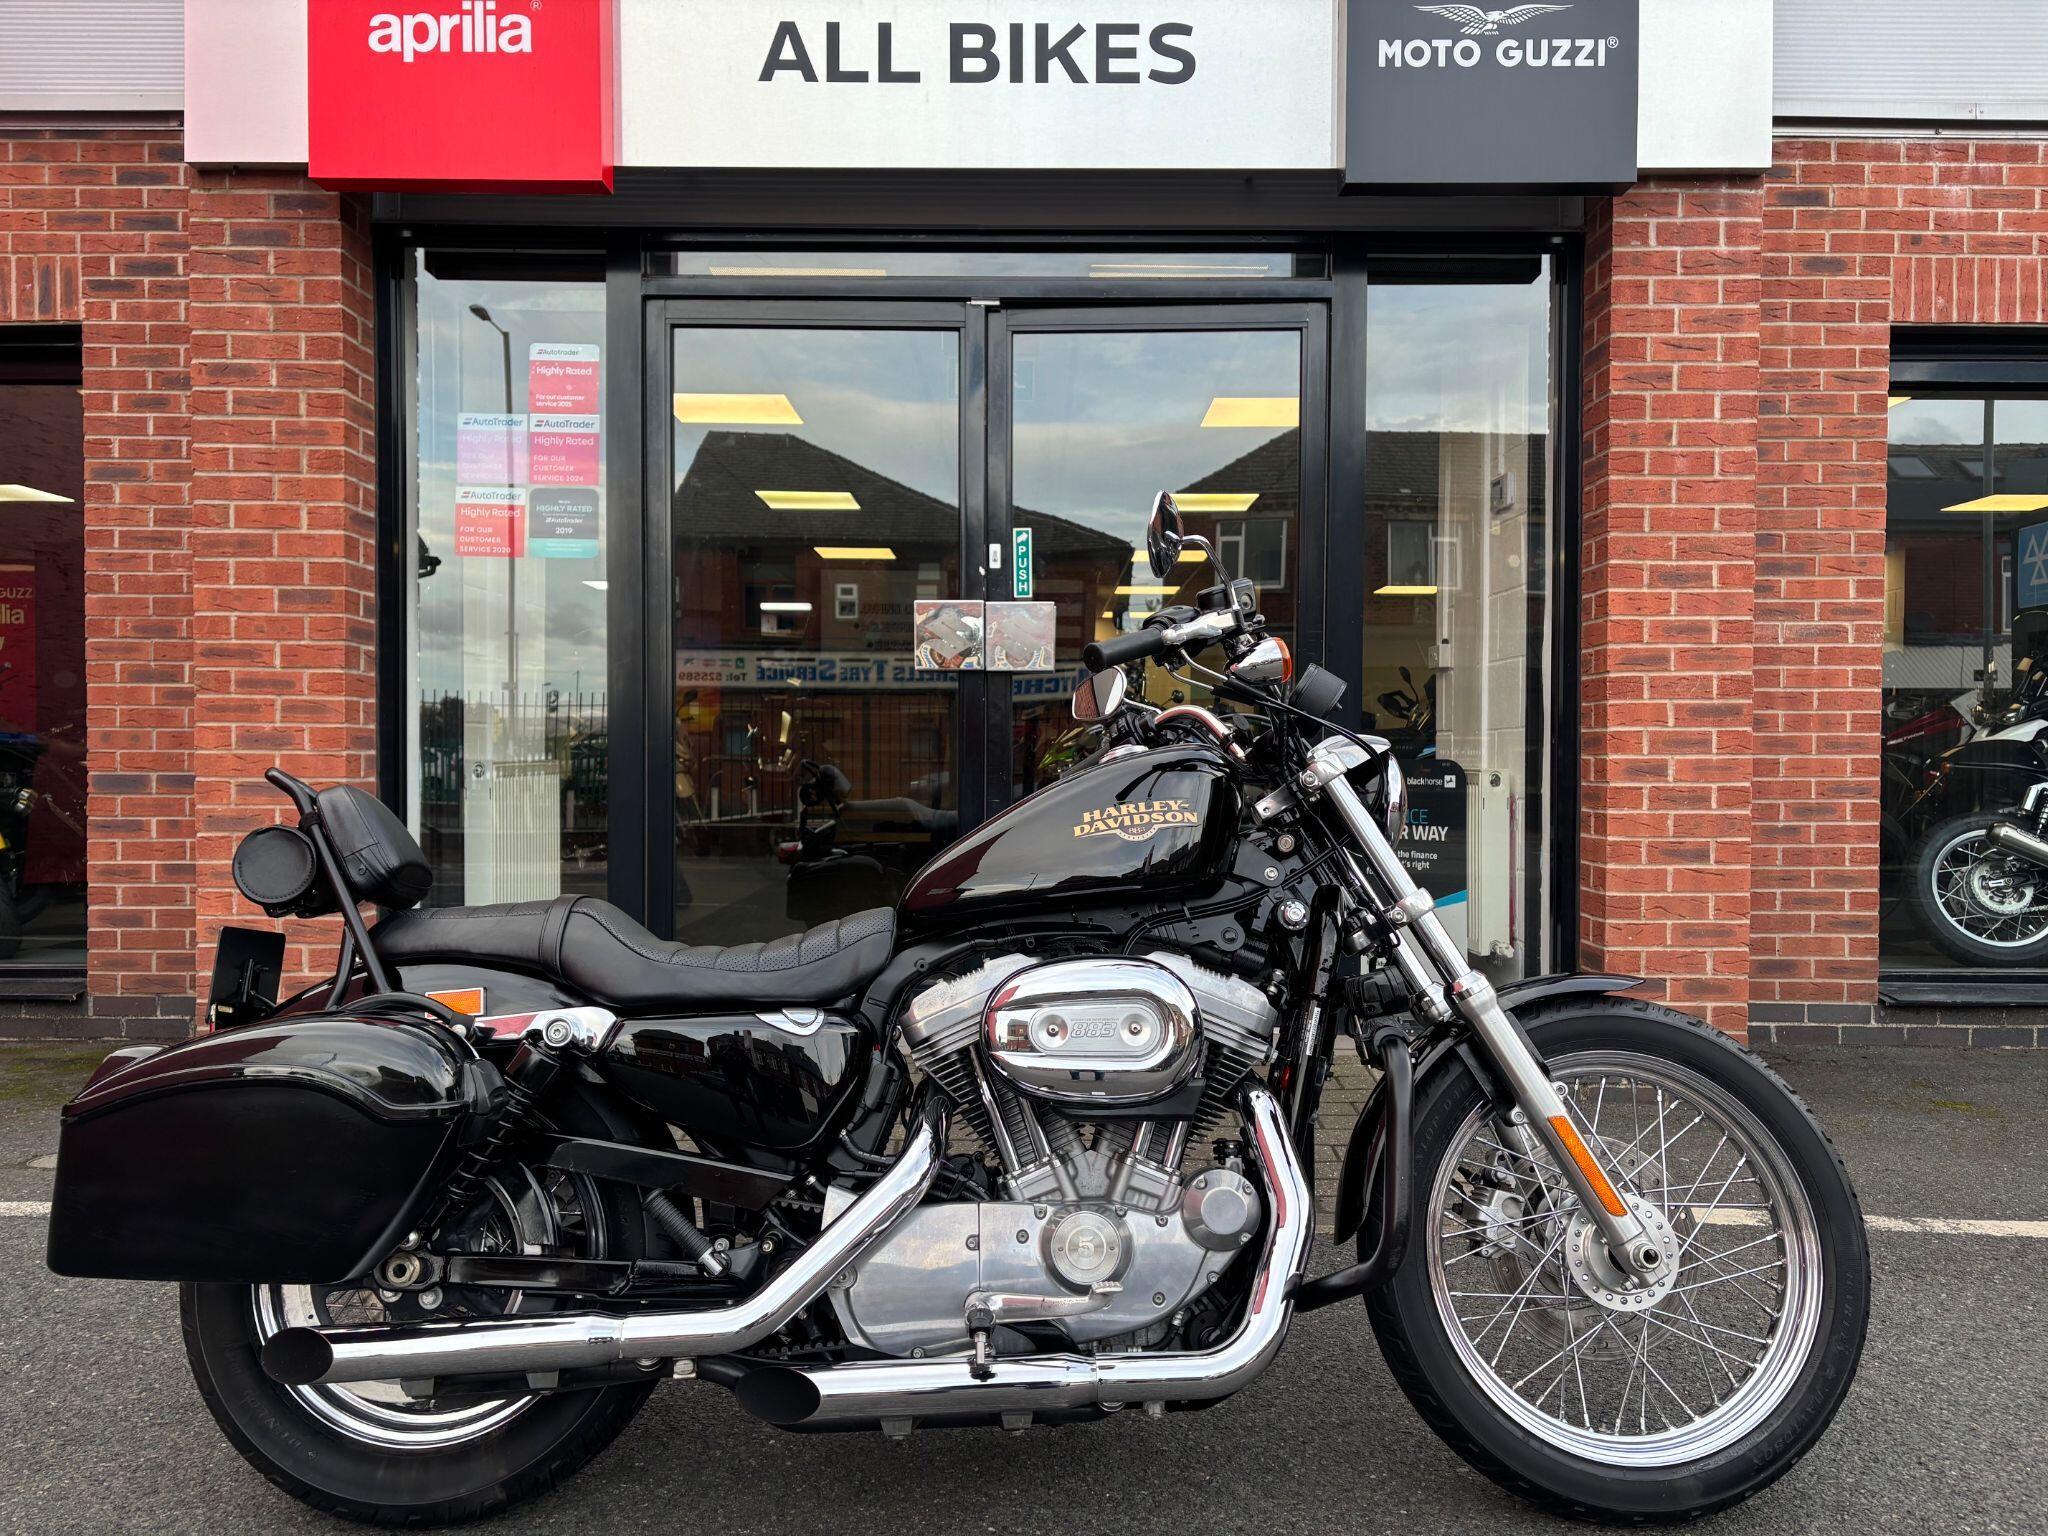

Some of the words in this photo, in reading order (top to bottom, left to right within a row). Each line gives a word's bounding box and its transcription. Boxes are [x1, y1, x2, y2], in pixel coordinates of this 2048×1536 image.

[367, 0, 533, 63] aprilia
[757, 20, 921, 84] ALL
[949, 21, 1197, 85] BIKES
[1377, 38, 1482, 68] MOTO
[1495, 38, 1606, 68] GUZZI
[536, 366, 564, 377] Highly
[565, 366, 592, 376] Rated
[472, 417, 524, 427] AutoTrader
[543, 419, 595, 429] AutoTrader
[534, 435, 564, 447] Highly
[565, 436, 594, 446] Rated
[470, 491, 521, 500] AutoTrader
[460, 507, 490, 518] Highly
[492, 508, 520, 518] Rated
[536, 504, 565, 512] HIGHLY
[566, 505, 593, 513] RATED
[555, 527, 573, 535] 2019
[1018, 545, 1028, 592] PUSH
[1073, 812, 1198, 838] DAVIDSON
[1412, 825, 1448, 842] WAY
[1397, 850, 1409, 859] the
[1410, 850, 1438, 860] finance
[1412, 860, 1430, 870] right
[1070, 1021, 1118, 1038] 883
